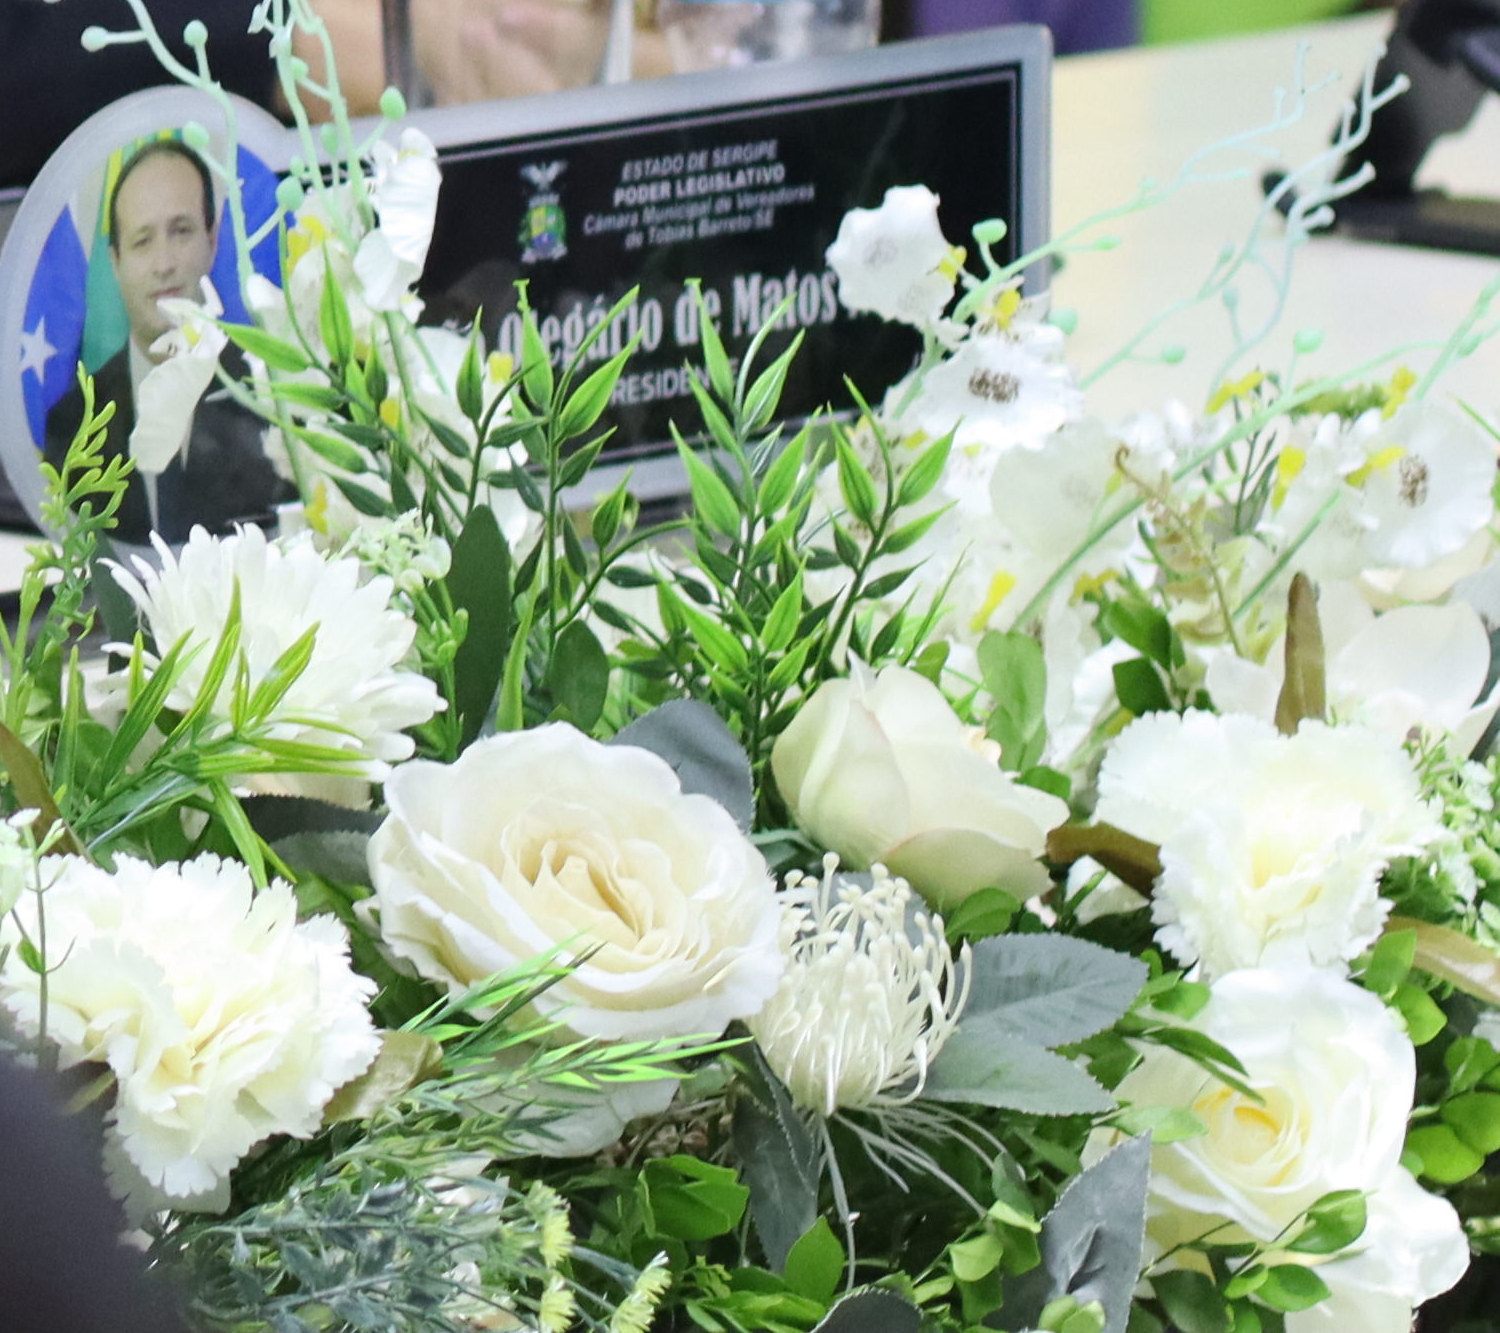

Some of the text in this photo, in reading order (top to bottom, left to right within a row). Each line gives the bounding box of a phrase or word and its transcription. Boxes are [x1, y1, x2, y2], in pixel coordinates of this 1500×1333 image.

[622, 139, 778, 181] ESTADO DE SERGIPE
[613, 162, 785, 207] PODER LEGISLATIVO
[643, 199, 712, 225] Municipal
[715, 196, 732, 213] de
[736, 185, 815, 208] Vereadores
[648, 222, 694, 244] Tobias
[497, 294, 663, 378] Oegário
[675, 279, 722, 347] de
[733, 267, 838, 337] Matos
